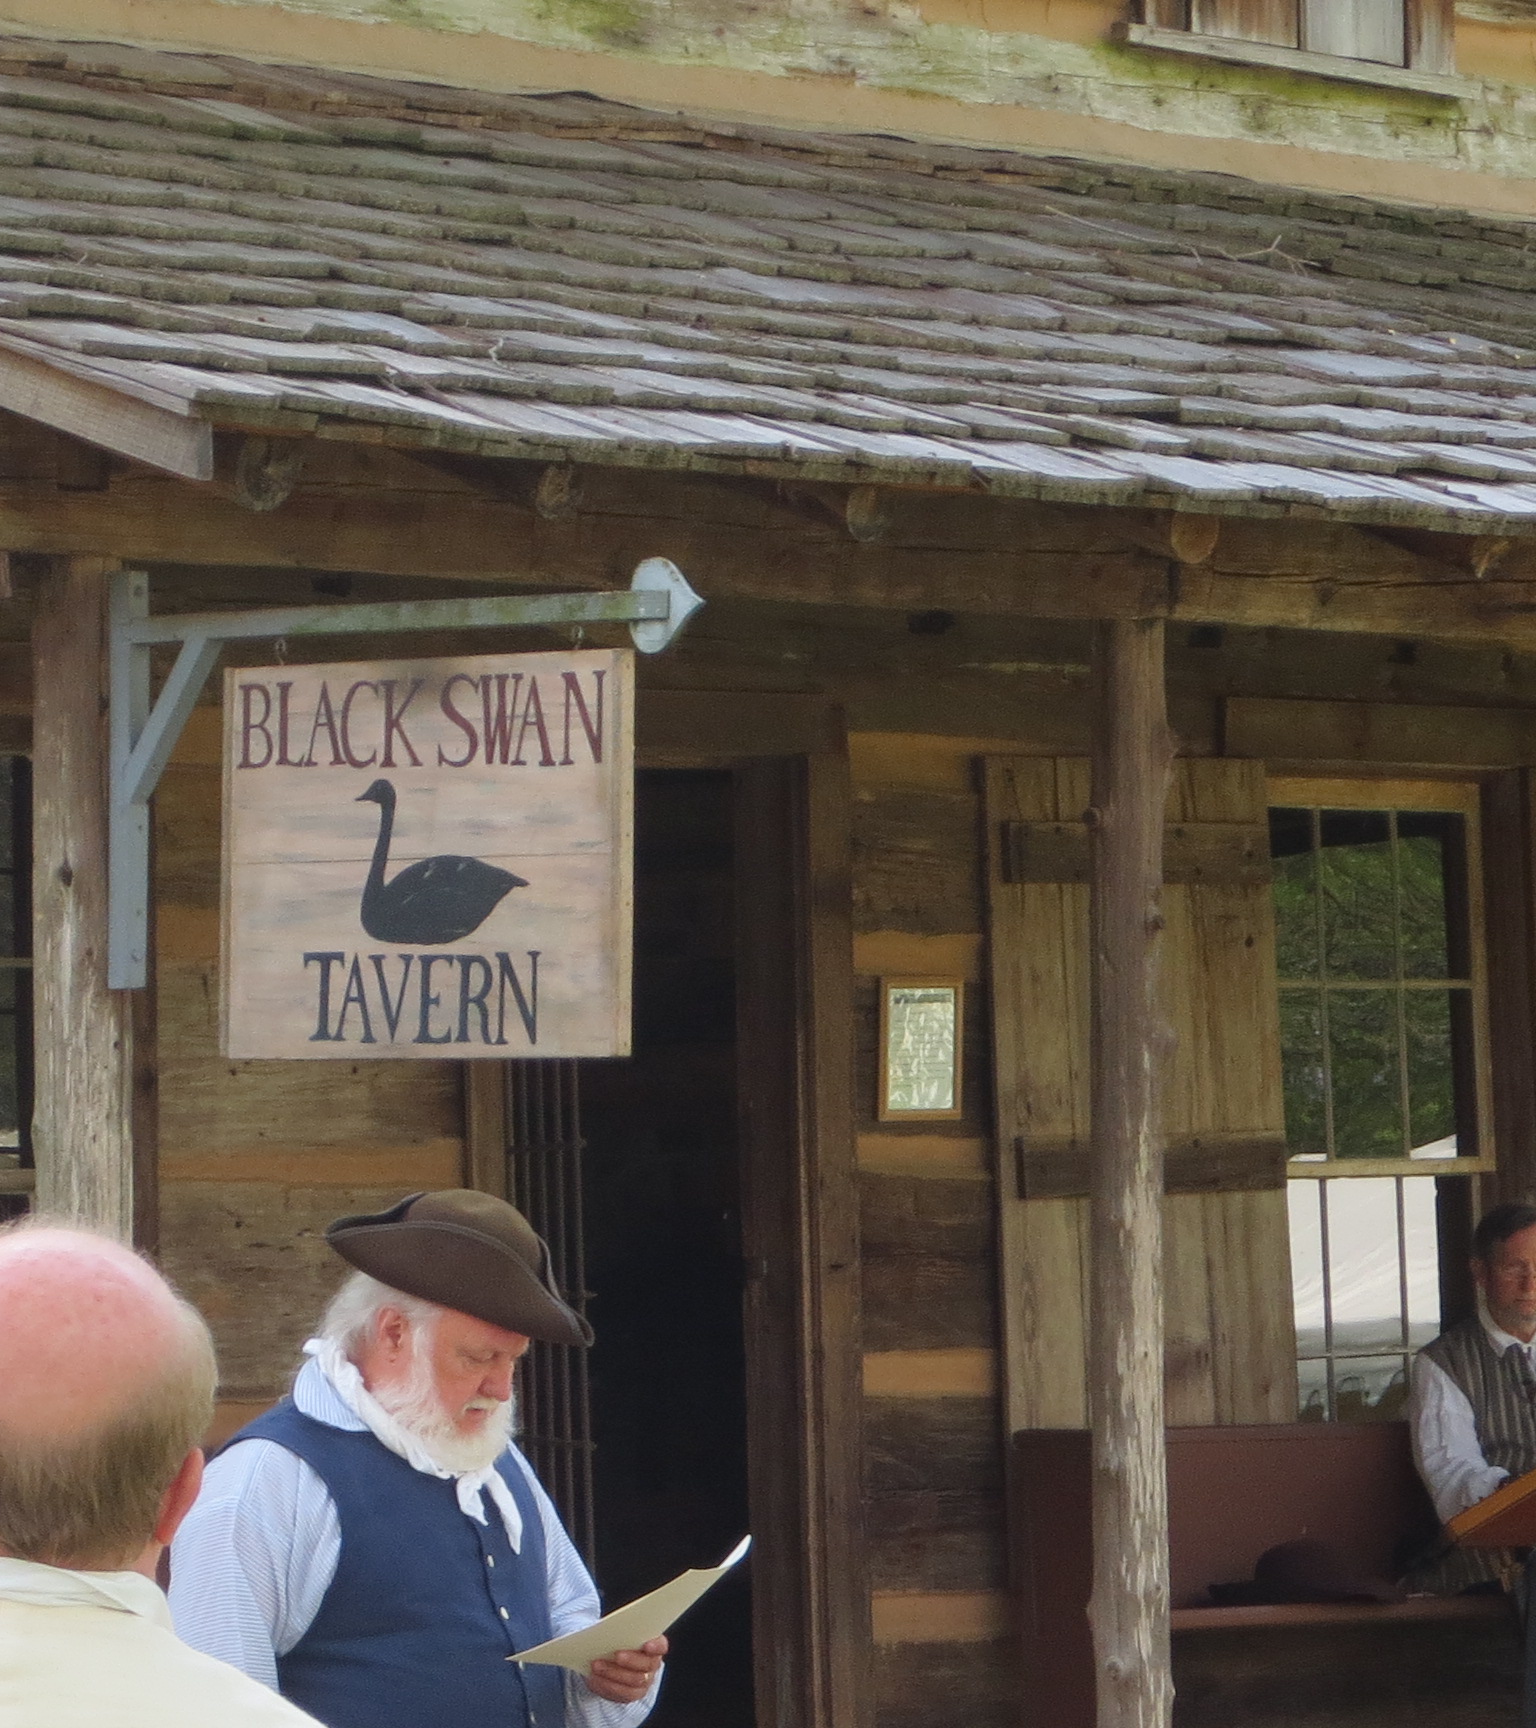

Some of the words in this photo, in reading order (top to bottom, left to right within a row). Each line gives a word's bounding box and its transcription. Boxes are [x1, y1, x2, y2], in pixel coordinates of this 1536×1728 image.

[237, 681, 424, 769] BLACK
[437, 670, 607, 767] SWAN
[303, 950, 542, 1046] TAVERN
